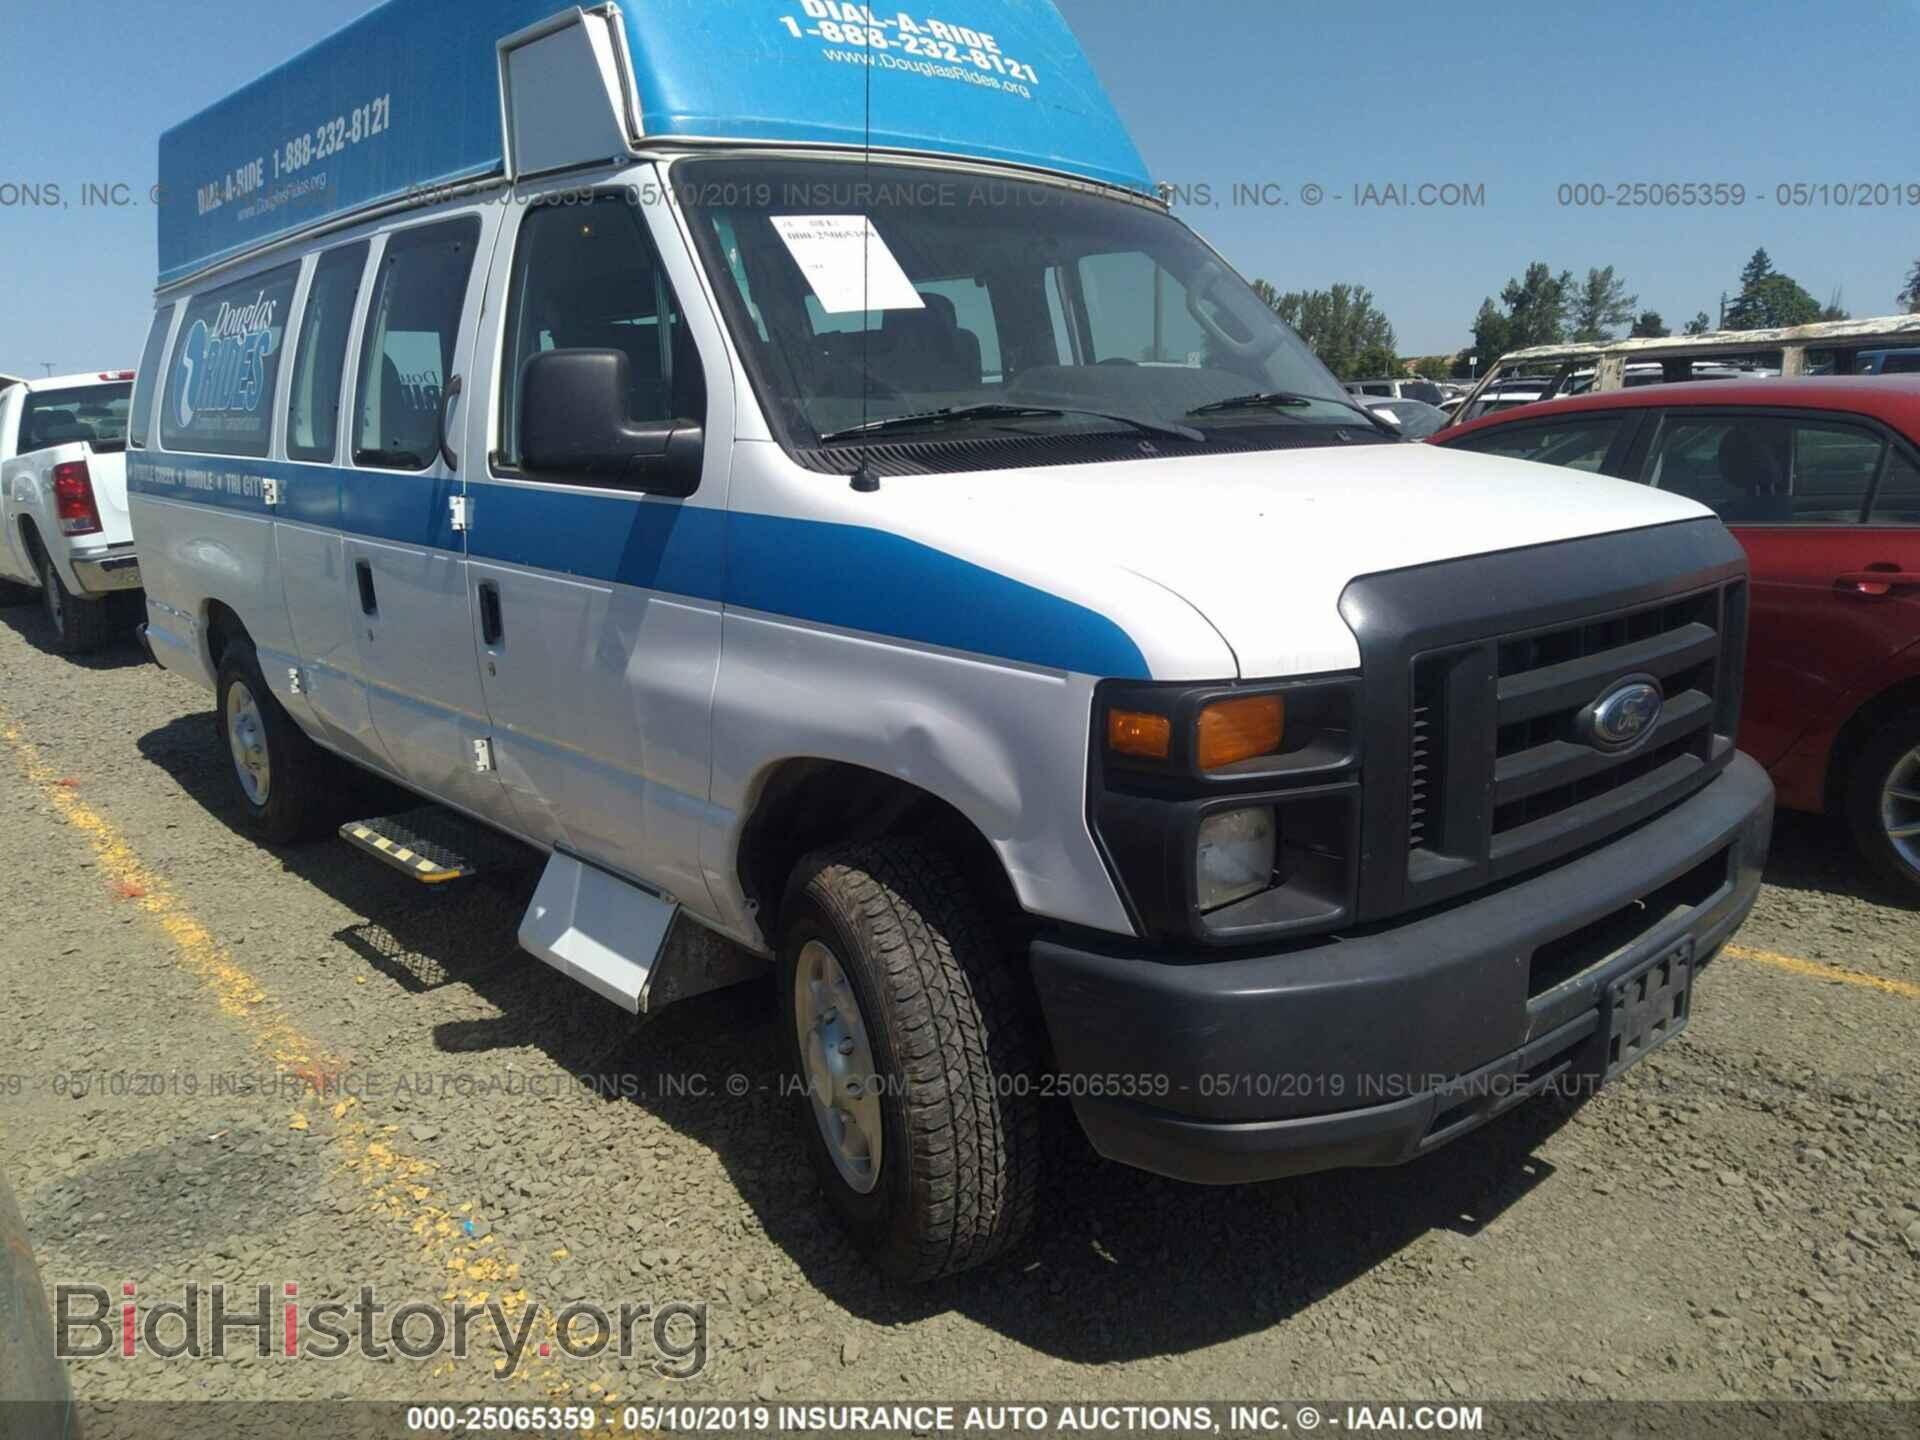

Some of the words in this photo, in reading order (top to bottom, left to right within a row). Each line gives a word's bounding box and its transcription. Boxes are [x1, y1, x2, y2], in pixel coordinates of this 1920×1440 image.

[779, 16, 1038, 84] 1-888-232-8121
[801, 0, 1002, 54] DIAL-A-RIDE
[822, 48, 1031, 98] www.DouglasRides.org
[197, 157, 264, 216] DIAL-A-RIDE
[273, 93, 390, 179] 1-888-232-8121
[211, 290, 277, 346] Douglas
